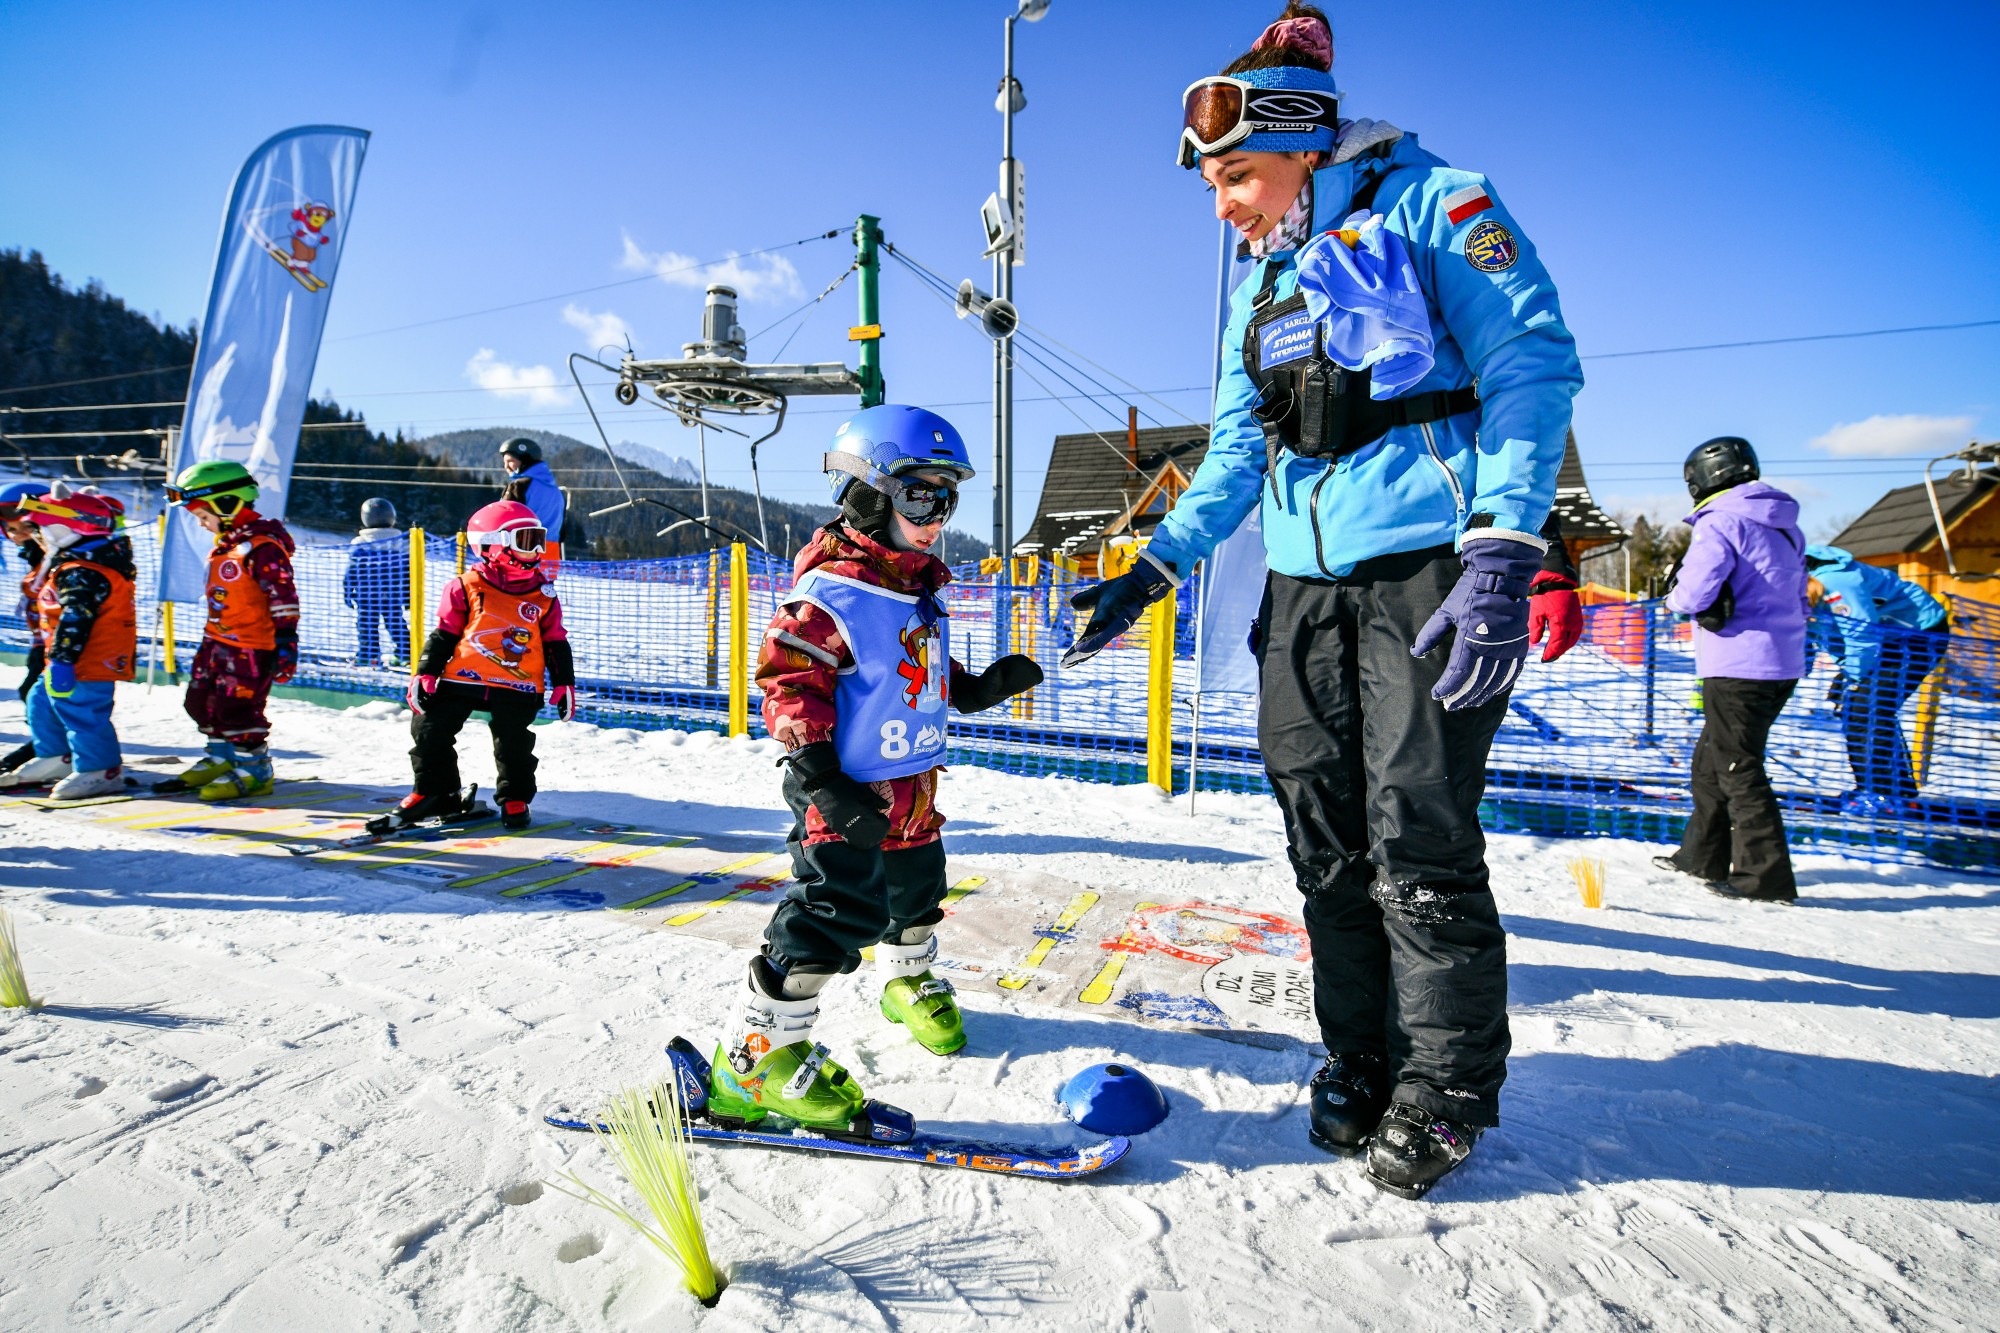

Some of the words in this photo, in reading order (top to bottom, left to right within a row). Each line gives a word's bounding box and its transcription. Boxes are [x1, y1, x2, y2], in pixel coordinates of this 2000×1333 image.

[1273, 328, 1312, 349] STRAMA
[1270, 340, 1315, 360] WWW.NOSAL.P
[880, 719, 911, 759] 8
